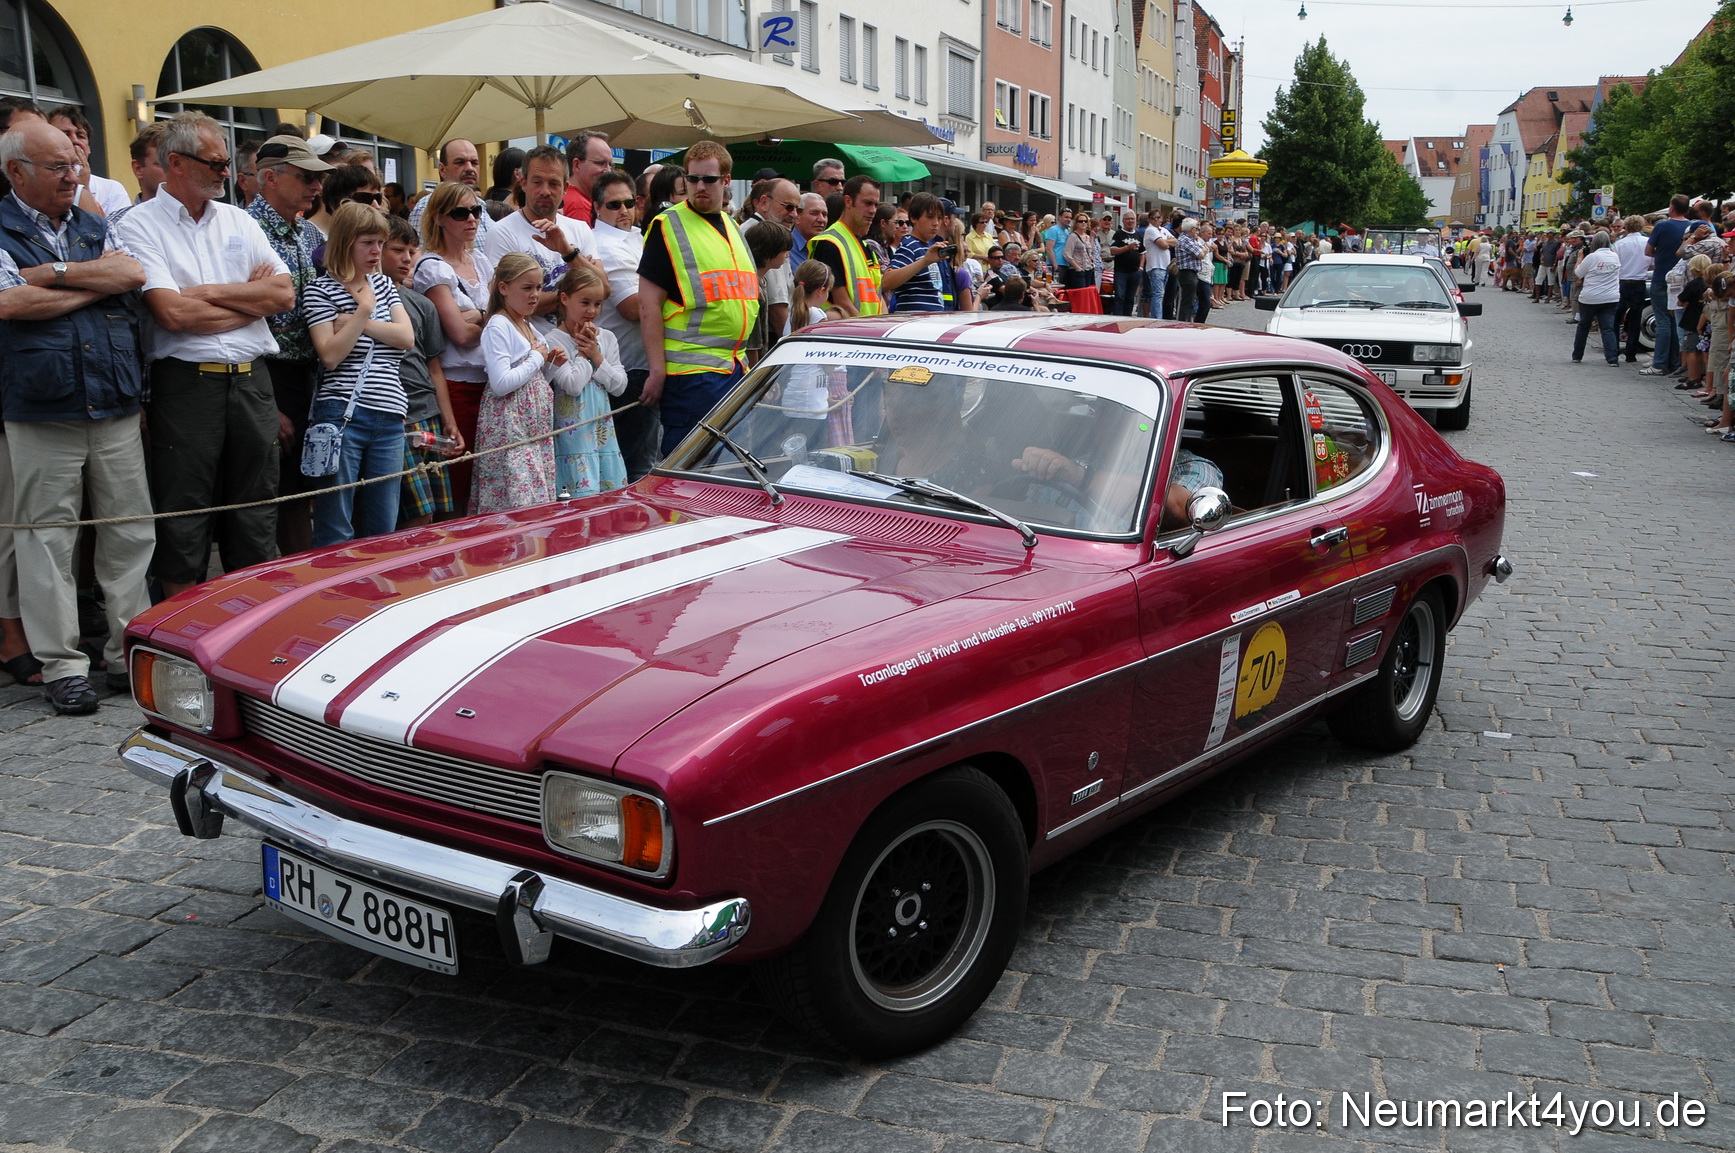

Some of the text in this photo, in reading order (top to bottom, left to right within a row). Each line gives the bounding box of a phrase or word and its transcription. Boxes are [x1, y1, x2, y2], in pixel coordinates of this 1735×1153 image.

[763, 16, 795, 47] R.
[702, 271, 757, 298] THW
[804, 349, 1077, 383] www.zimmermann-tortechnik.de
[1317, 443, 1326, 456] 66
[857, 656, 920, 687] Toranlagen
[918, 650, 933, 667] für
[931, 640, 961, 660] Privat
[960, 633, 980, 650] und
[979, 621, 1017, 643] Industrie
[1247, 650, 1276, 699] 70
[279, 856, 453, 958] RH Z 888H
